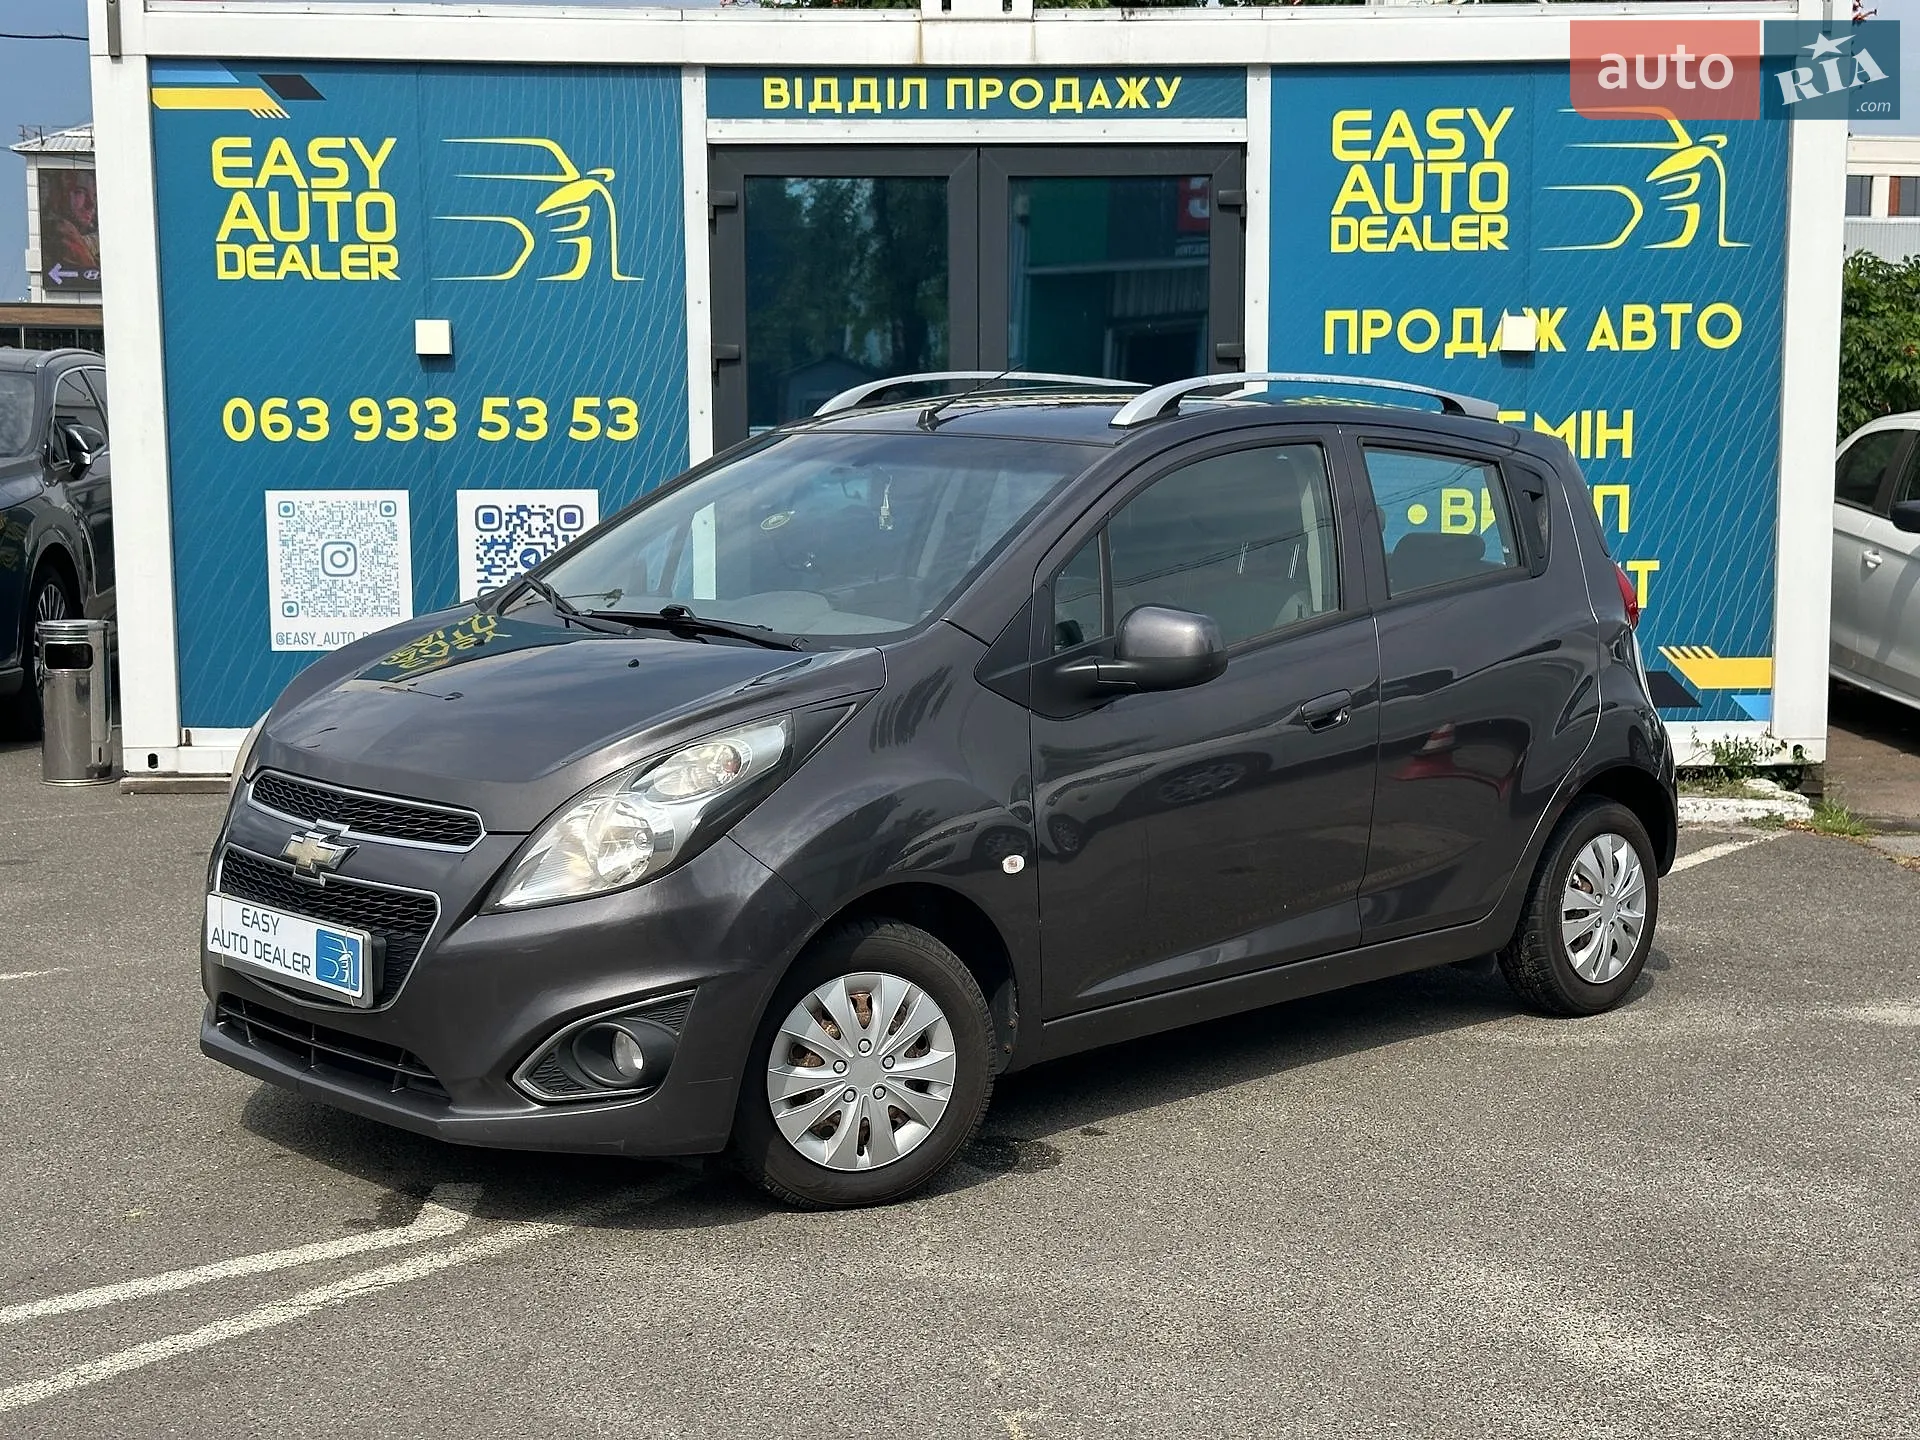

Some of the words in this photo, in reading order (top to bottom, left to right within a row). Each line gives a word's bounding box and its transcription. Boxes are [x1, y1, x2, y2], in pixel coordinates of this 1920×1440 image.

[763, 77, 928, 113] ВІДДІЛ
[946, 77, 1182, 113] ПРОДАЖУ
[1332, 107, 1513, 162] EASY
[211, 137, 396, 189] EASY
[1332, 162, 1509, 215] AUTO
[216, 191, 396, 243] AUTO
[1330, 214, 1508, 253] DEALER
[216, 243, 400, 281] DEALER
[1324, 306, 1567, 358] ПРОДЖ
[1586, 303, 1743, 352] АВТО
[222, 397, 330, 441] 063
[348, 397, 456, 441] 933
[477, 397, 548, 441] 53
[569, 396, 640, 441] 53
[241, 907, 280, 936] EASY
[211, 927, 249, 955] AUTO
[253, 939, 312, 976] DEALER
